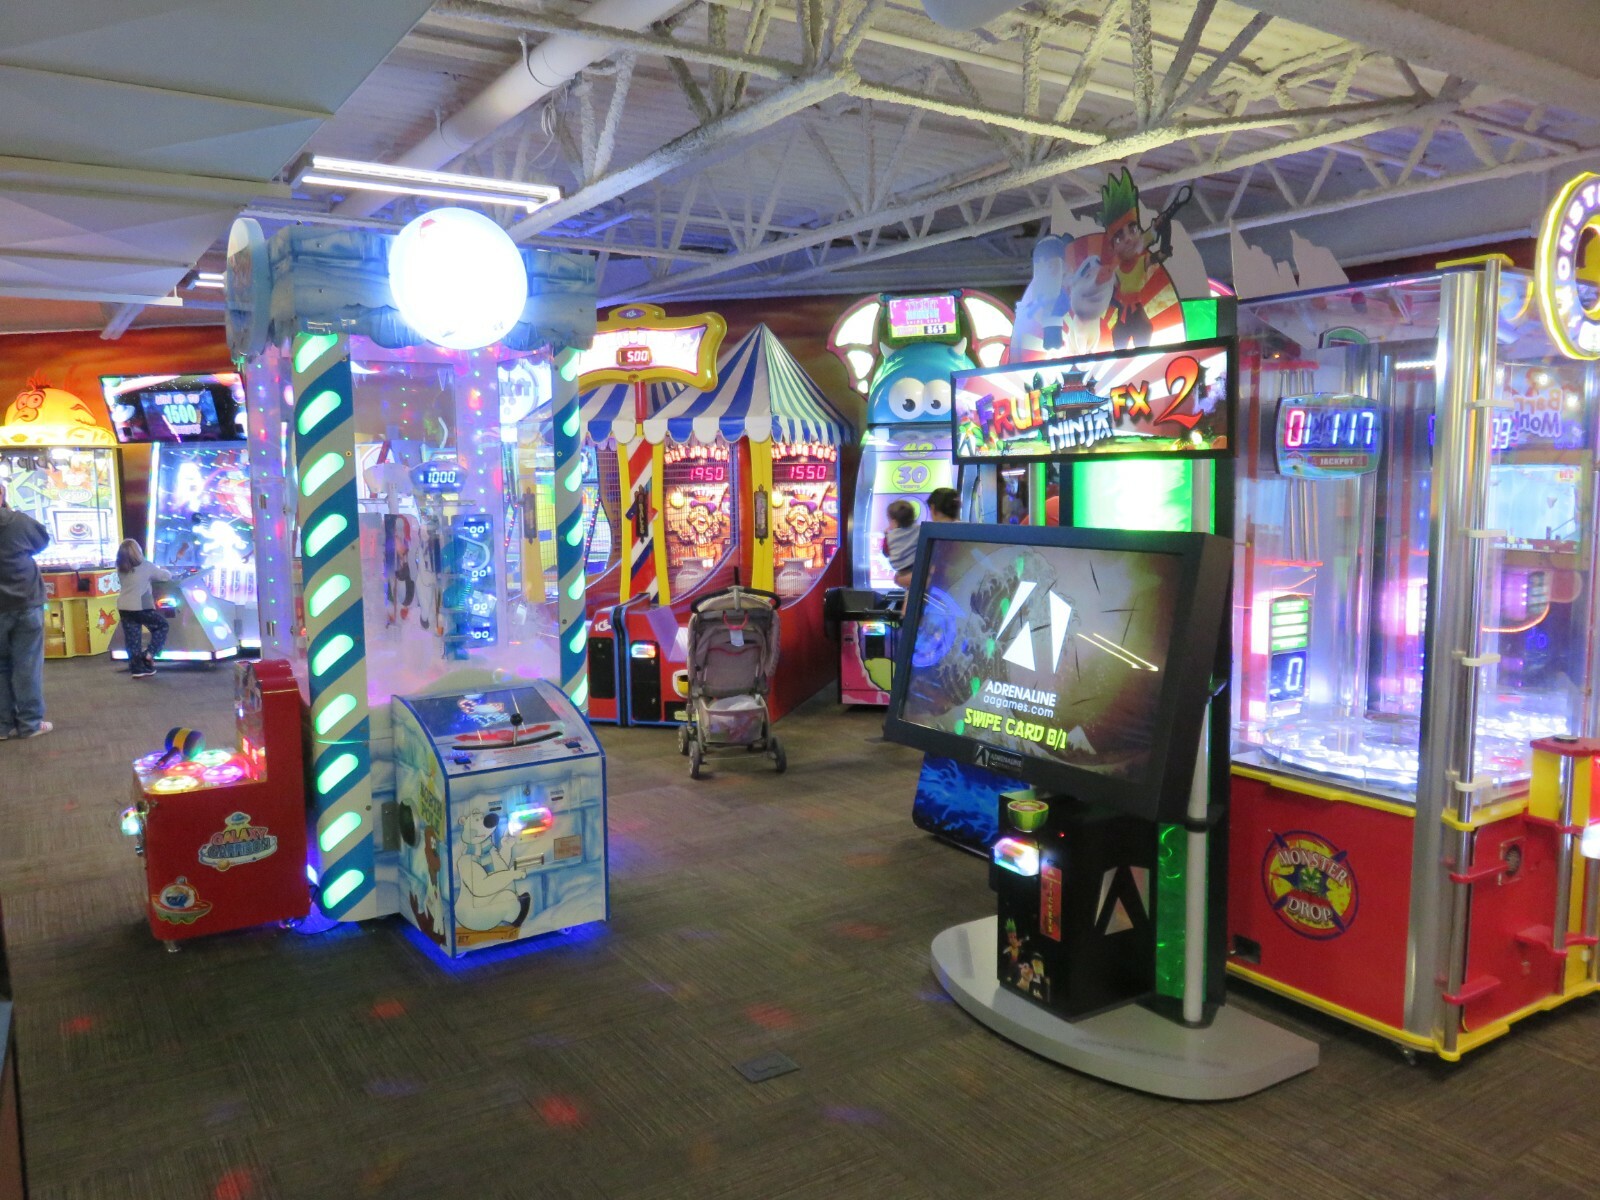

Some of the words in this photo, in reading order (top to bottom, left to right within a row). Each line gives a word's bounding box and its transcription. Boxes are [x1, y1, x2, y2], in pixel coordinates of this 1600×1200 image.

[926, 325, 944, 334] 865
[626, 350, 649, 362] 500
[1153, 356, 1203, 429] 2
[163, 403, 198, 424] 1500
[976, 383, 1060, 439] FRUIT
[1110, 380, 1151, 419] FX
[1048, 407, 1115, 451] NINJA
[903, 442, 933, 456] 40
[1320, 457, 1354, 466] JACKPOT
[427, 471, 456, 484] 1000
[690, 467, 724, 481] 1950
[790, 466, 826, 480] 1550
[896, 465, 928, 485] 30
[595, 619, 612, 632] ICE
[985, 680, 1057, 707] ADRENALINE
[983, 695, 1054, 718] aagames.com
[964, 707, 1003, 732] SWIPE
[1005, 717, 1045, 743] CARD
[1046, 728, 1068, 751] 0/1
[211, 827, 268, 846] GALAXY
[207, 837, 270, 859] GARRISON
[1278, 848, 1348, 885] MONSTER
[1287, 896, 1334, 921] DROP
